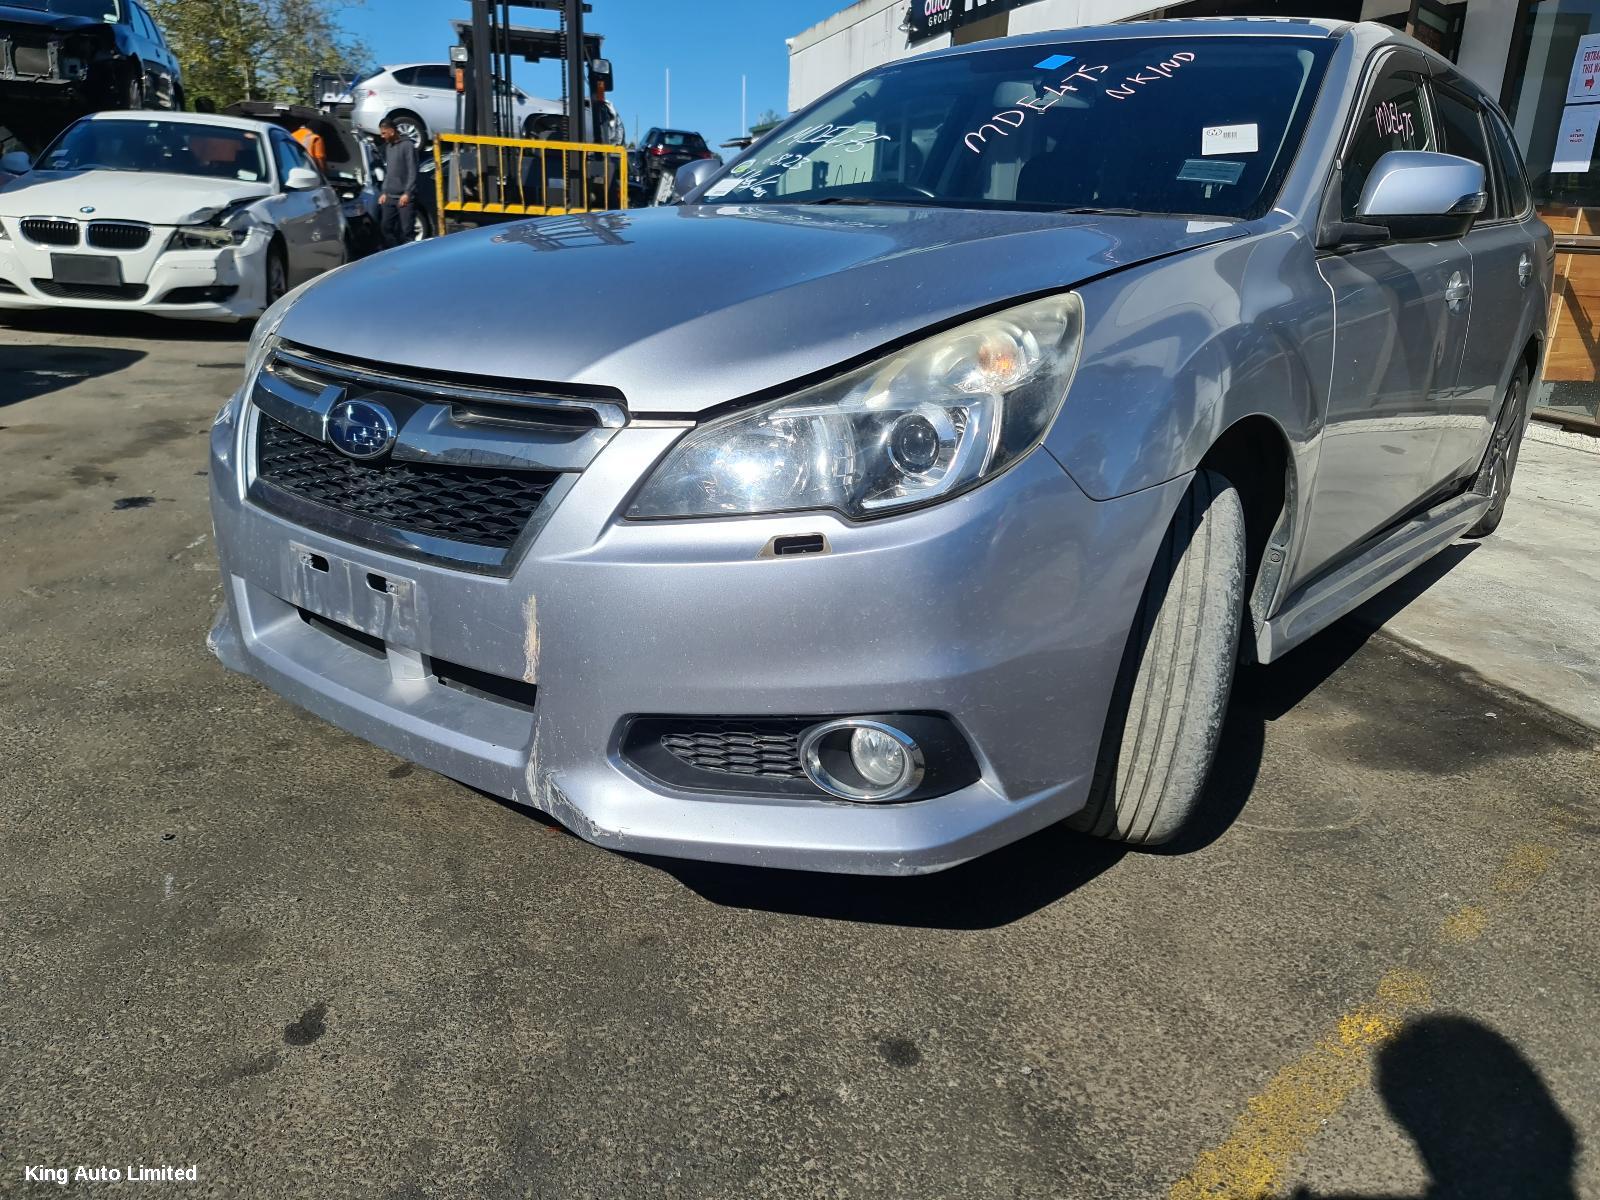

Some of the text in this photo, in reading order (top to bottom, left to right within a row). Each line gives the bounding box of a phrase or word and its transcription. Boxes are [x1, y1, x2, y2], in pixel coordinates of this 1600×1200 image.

[928, 9, 953, 27] GROUP
[964, 64, 1109, 154] MDE475
[1374, 101, 1415, 143] MDE475
